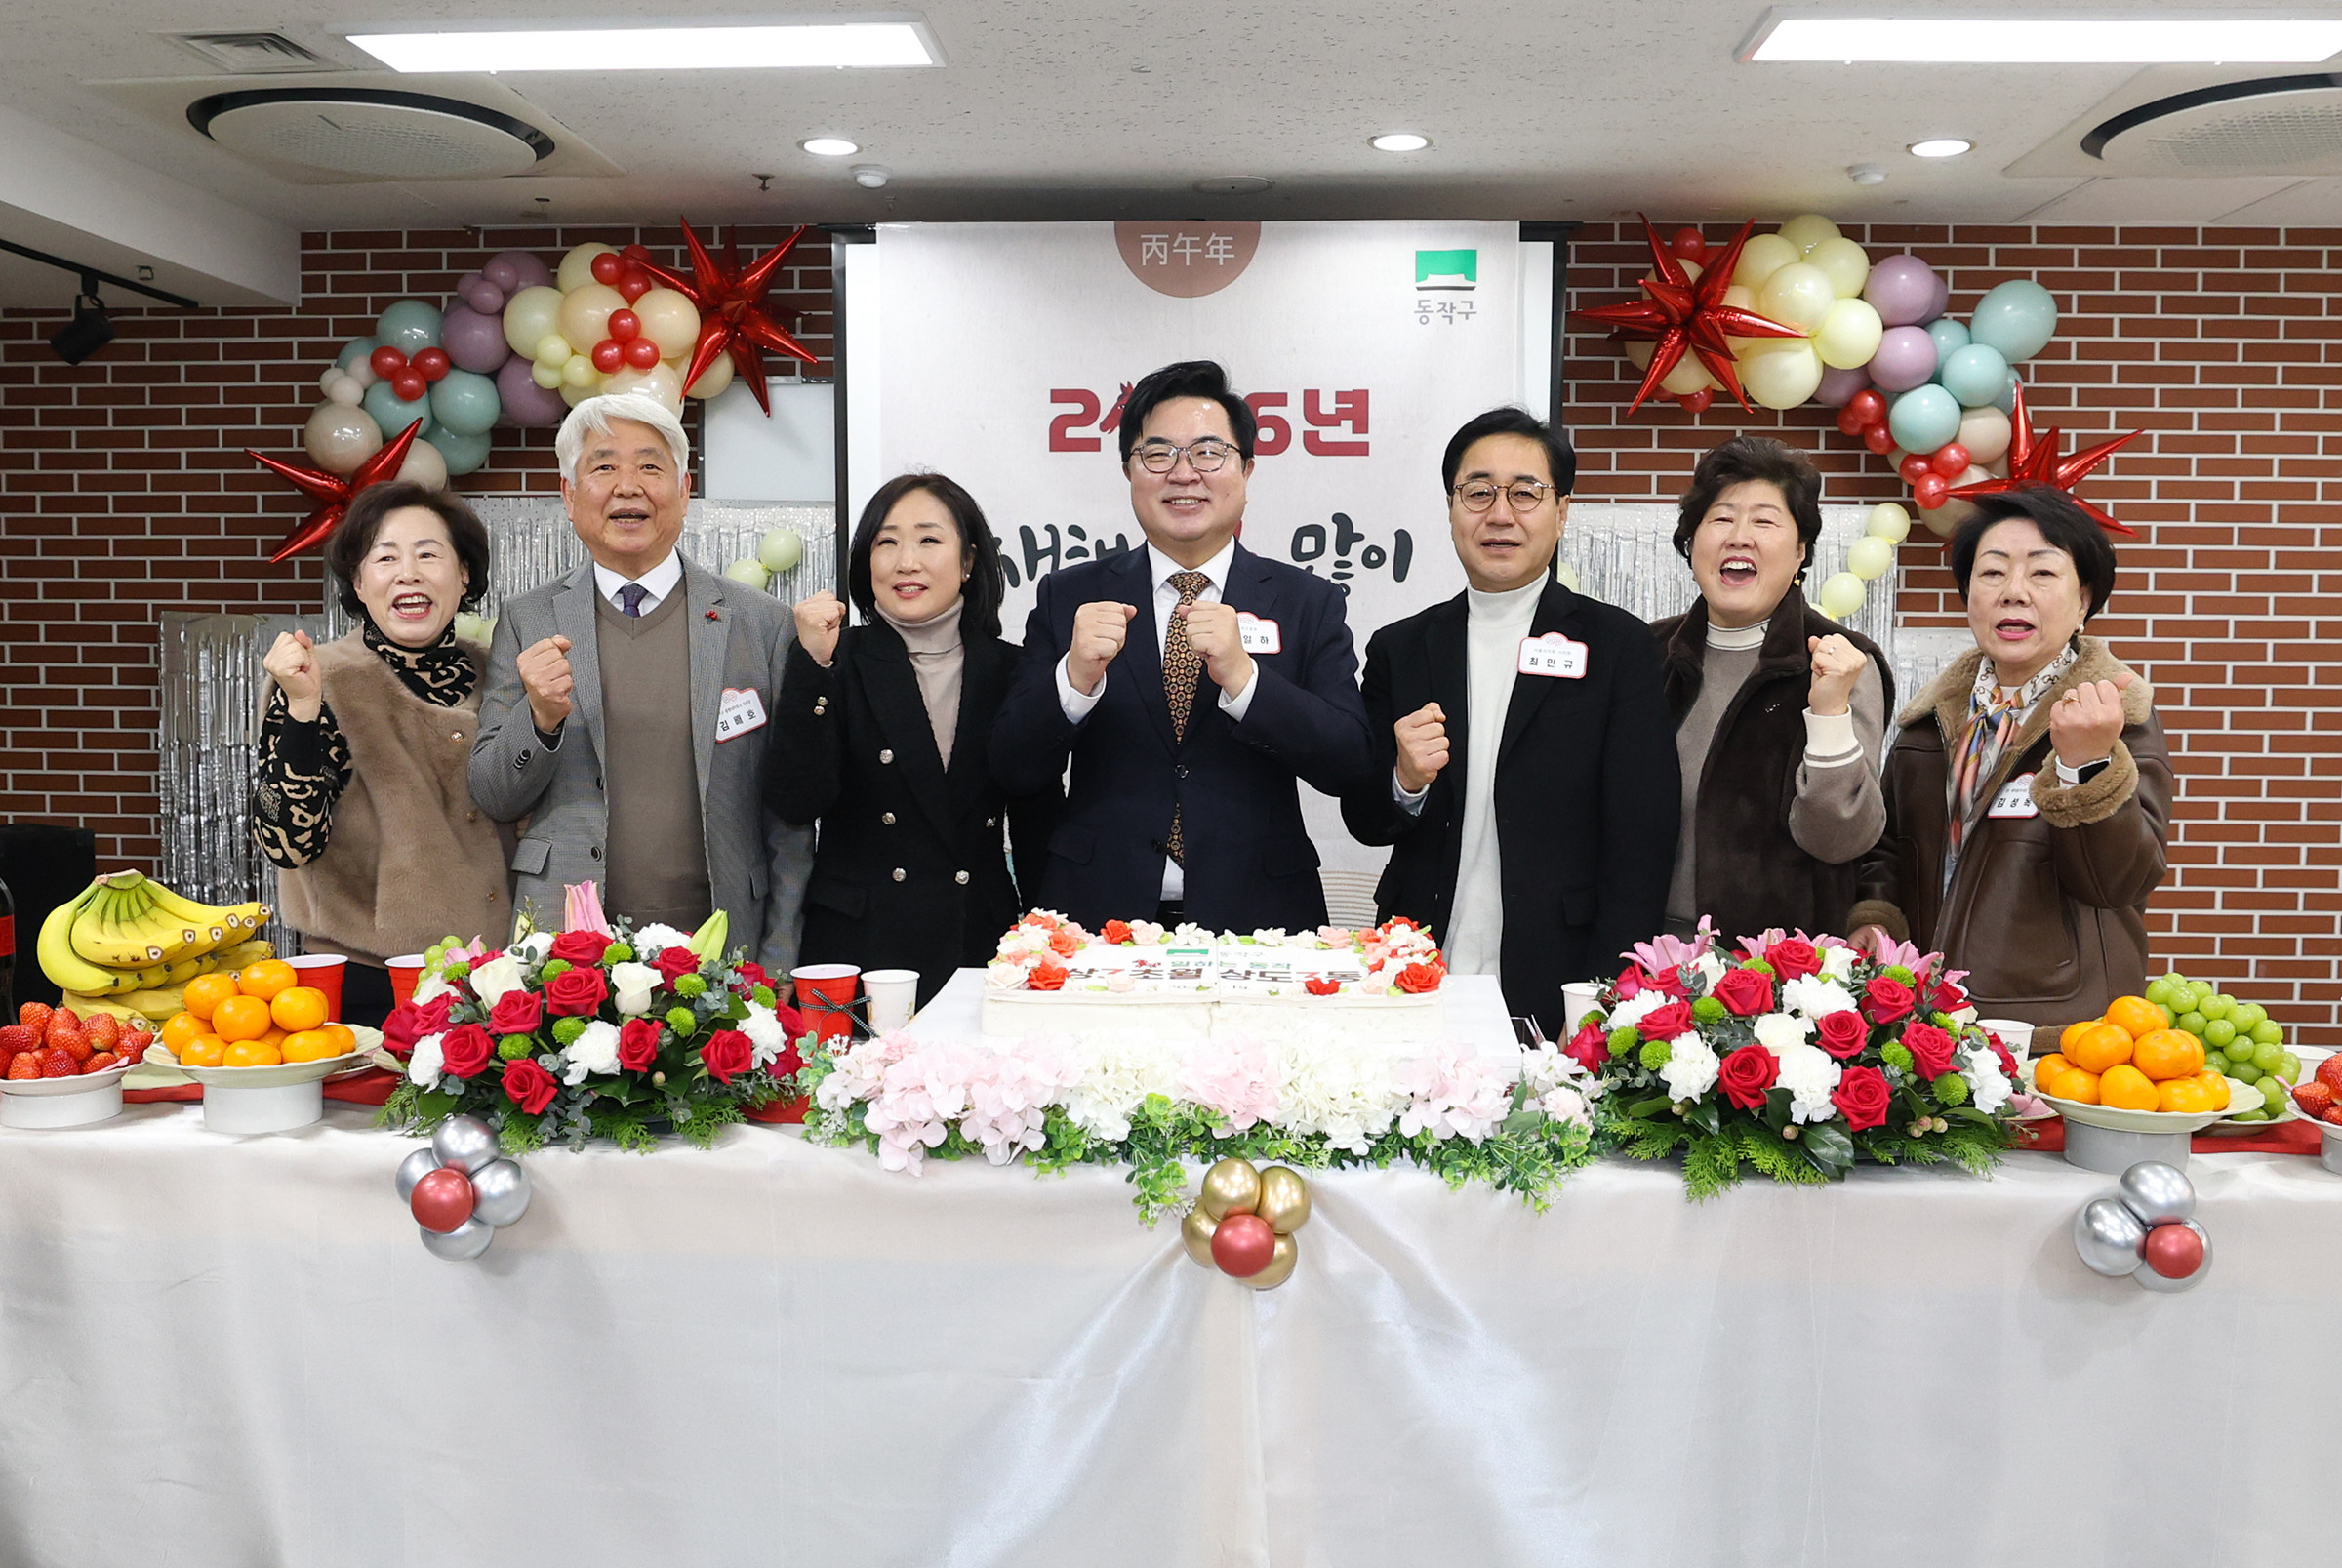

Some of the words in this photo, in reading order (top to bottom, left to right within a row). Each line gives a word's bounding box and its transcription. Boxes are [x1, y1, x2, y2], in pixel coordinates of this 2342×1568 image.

[1140, 232, 1235, 266] 丙午年
[1413, 299, 1477, 325] 동작구
[1049, 388, 1369, 456] 26년
[1529, 656, 1573, 669] 최민규
[720, 709, 756, 731] 김호
